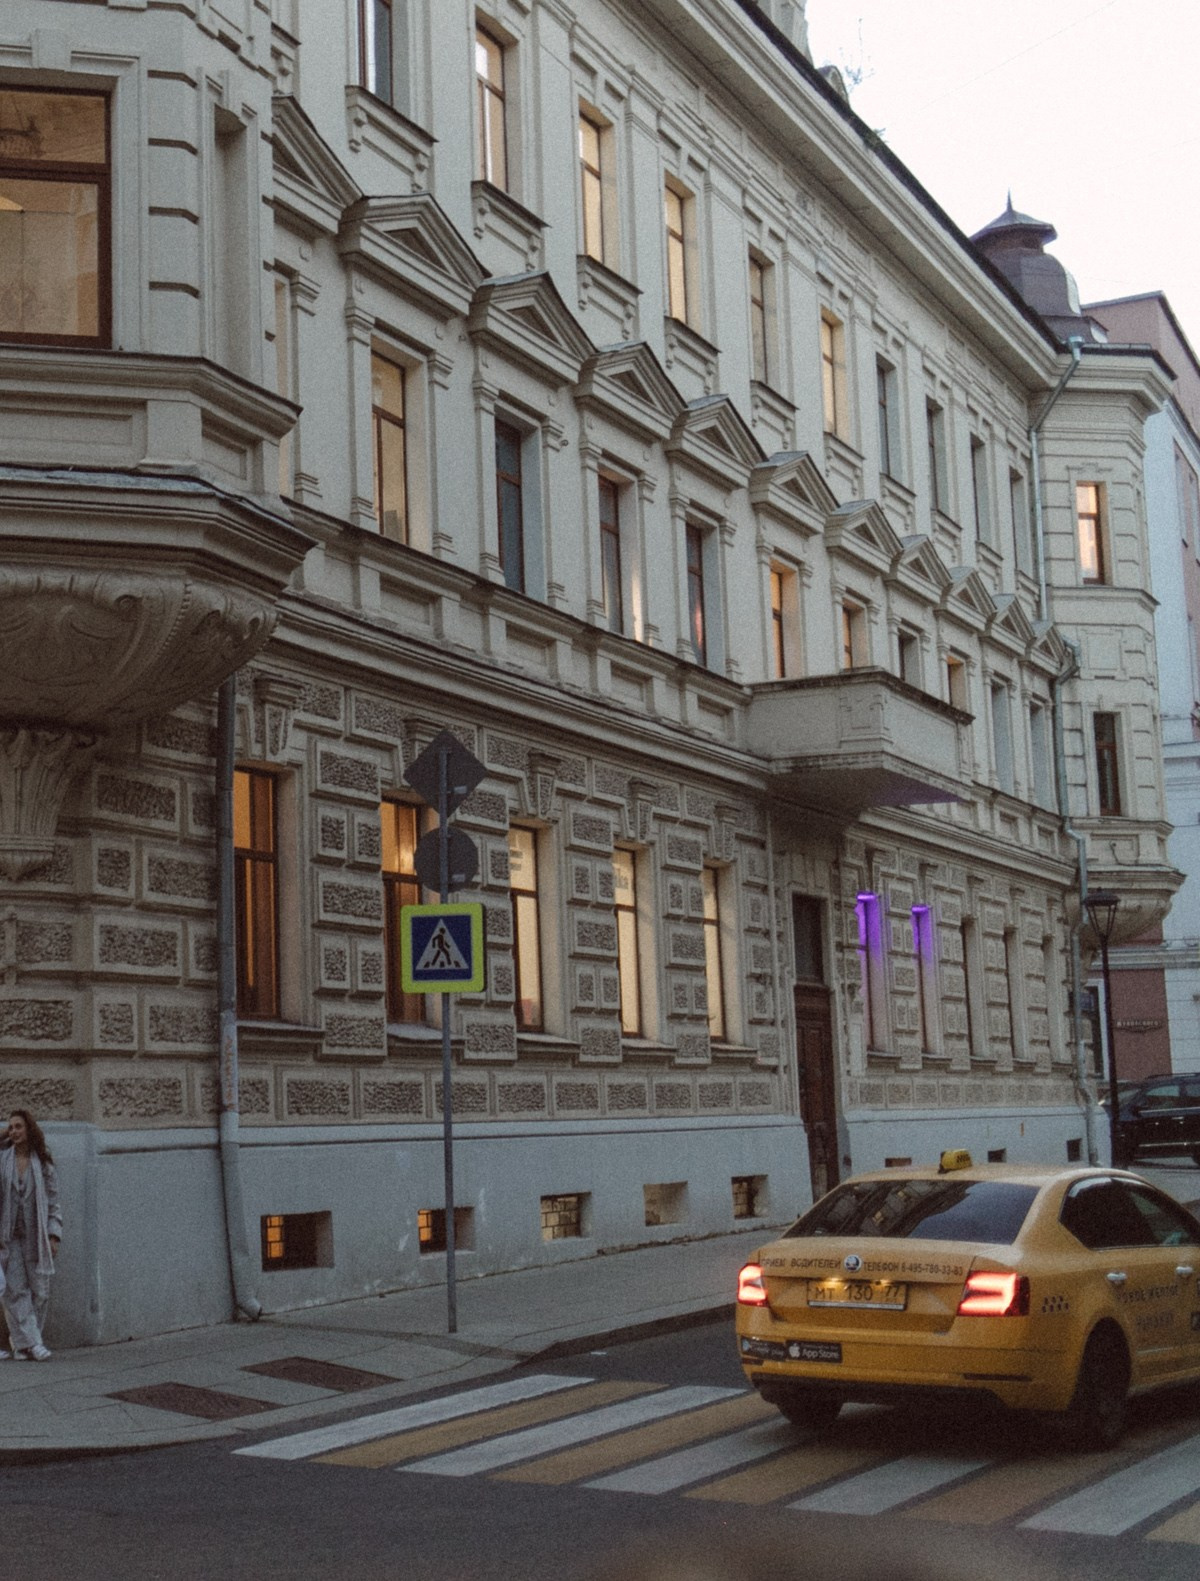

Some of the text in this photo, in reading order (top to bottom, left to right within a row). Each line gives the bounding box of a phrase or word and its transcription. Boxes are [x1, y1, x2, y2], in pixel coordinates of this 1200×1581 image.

[790, 1257, 842, 1269] ВОДИТЕЛЕЙ
[863, 1261, 899, 1272] ТЕЛЕФОН
[815, 1284, 901, 1301] МТ 130 77
[802, 1349, 840, 1359] App Store
